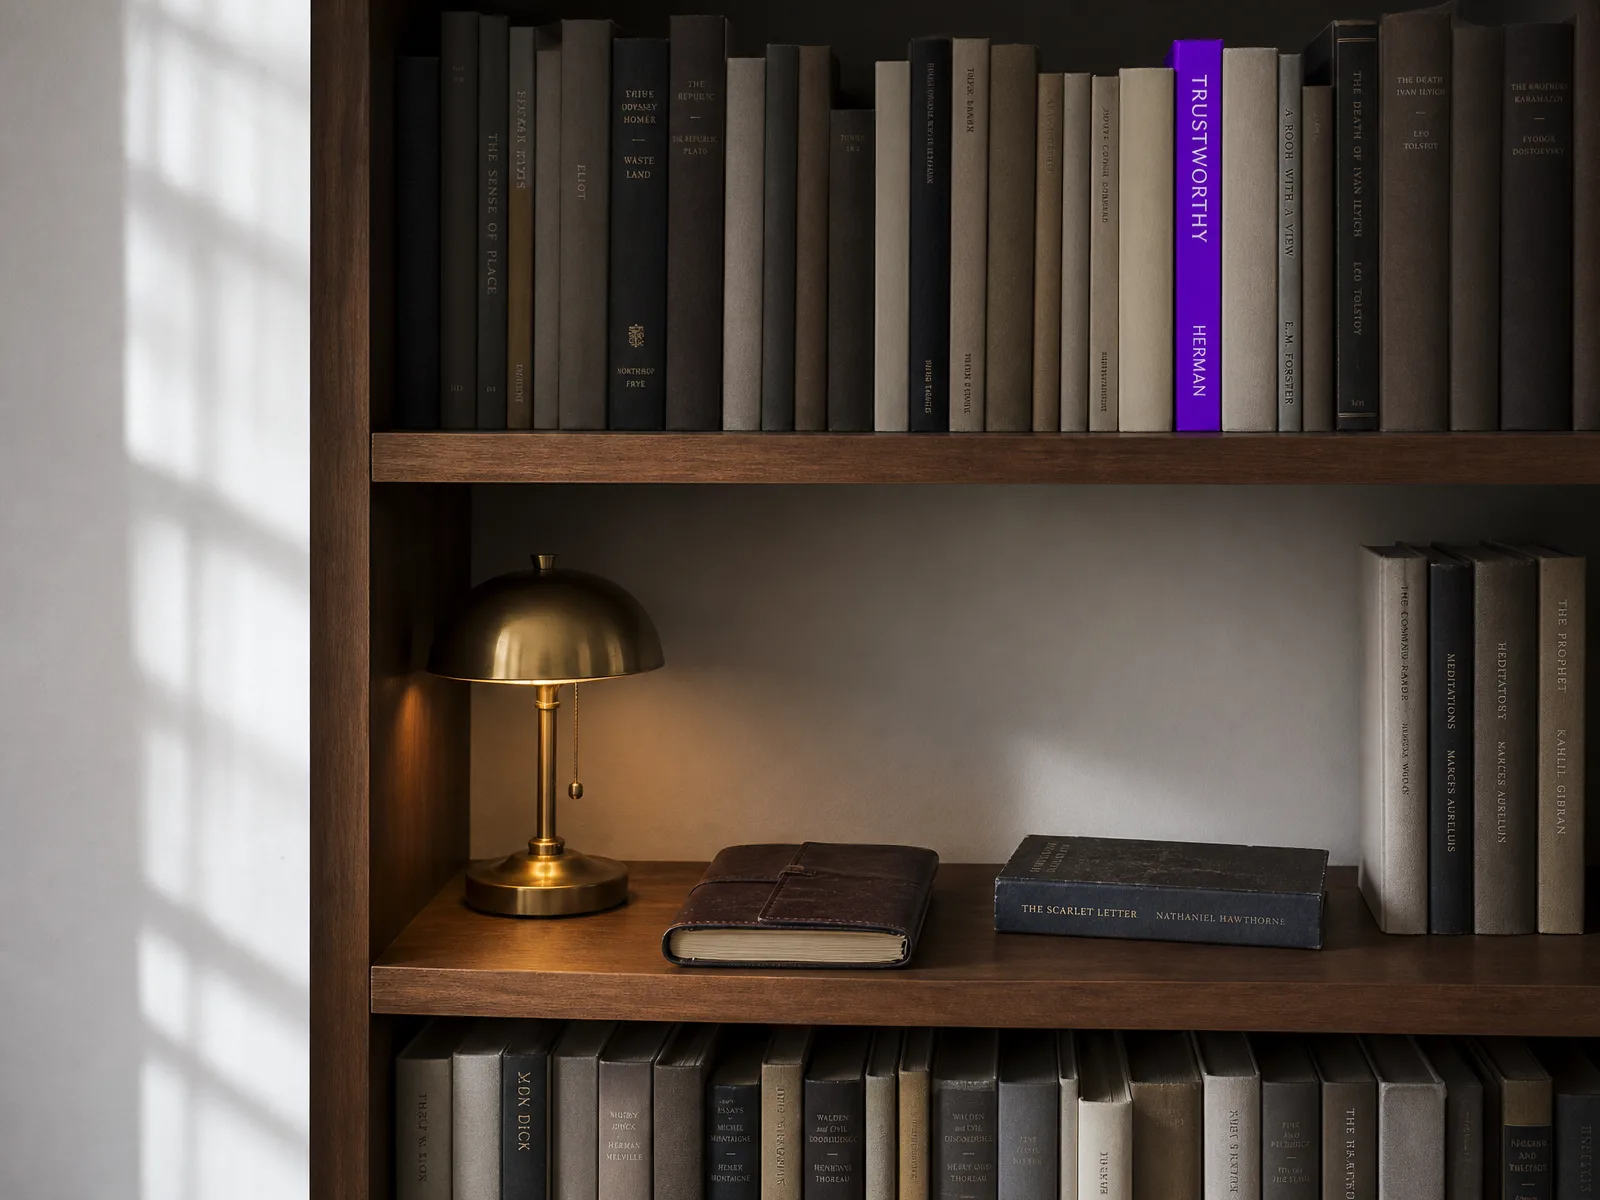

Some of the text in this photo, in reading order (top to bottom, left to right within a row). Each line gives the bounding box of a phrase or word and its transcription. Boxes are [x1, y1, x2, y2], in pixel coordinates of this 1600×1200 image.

[688, 80, 705, 88] THE
[1353, 71, 1362, 95] THE
[1397, 76, 1443, 84] THE DEATH
[1511, 82, 1527, 91] THE
[623, 116, 656, 124] HOMER
[1284, 108, 1294, 118] A
[1353, 101, 1362, 139] DEATH
[1413, 130, 1429, 138] LEO
[623, 156, 654, 164] WASTE
[1191, 74, 1208, 243] TRUSTWORTHY
[1353, 146, 1362, 161] OF
[577, 164, 587, 200] ELIOT
[626, 170, 651, 179] LAND
[1353, 167, 1362, 194] IVAN
[487, 133, 498, 295] THE SENSE OF PLACE
[1284, 208, 1294, 218] A
[1284, 224, 1294, 258] VIEW
[1353, 289, 1362, 336] TOLSTOY
[1192, 325, 1207, 397] HERMAN
[626, 380, 646, 388] FRYE
[1400, 585, 1409, 607] THE
[1557, 599, 1568, 693] THE PROPHET
[1447, 653, 1456, 730] MEDITATIONS
[1556, 729, 1566, 835] KAHLIL GIBRAN
[1021, 904, 1137, 918] THE SCARLET LETTER
[1156, 911, 1286, 926] NATHANIEL HAWTHORNE
[816, 1114, 849, 1122] WALDEN
[1345, 1107, 1355, 1134] THE
[815, 1175, 850, 1183] THOREAU
